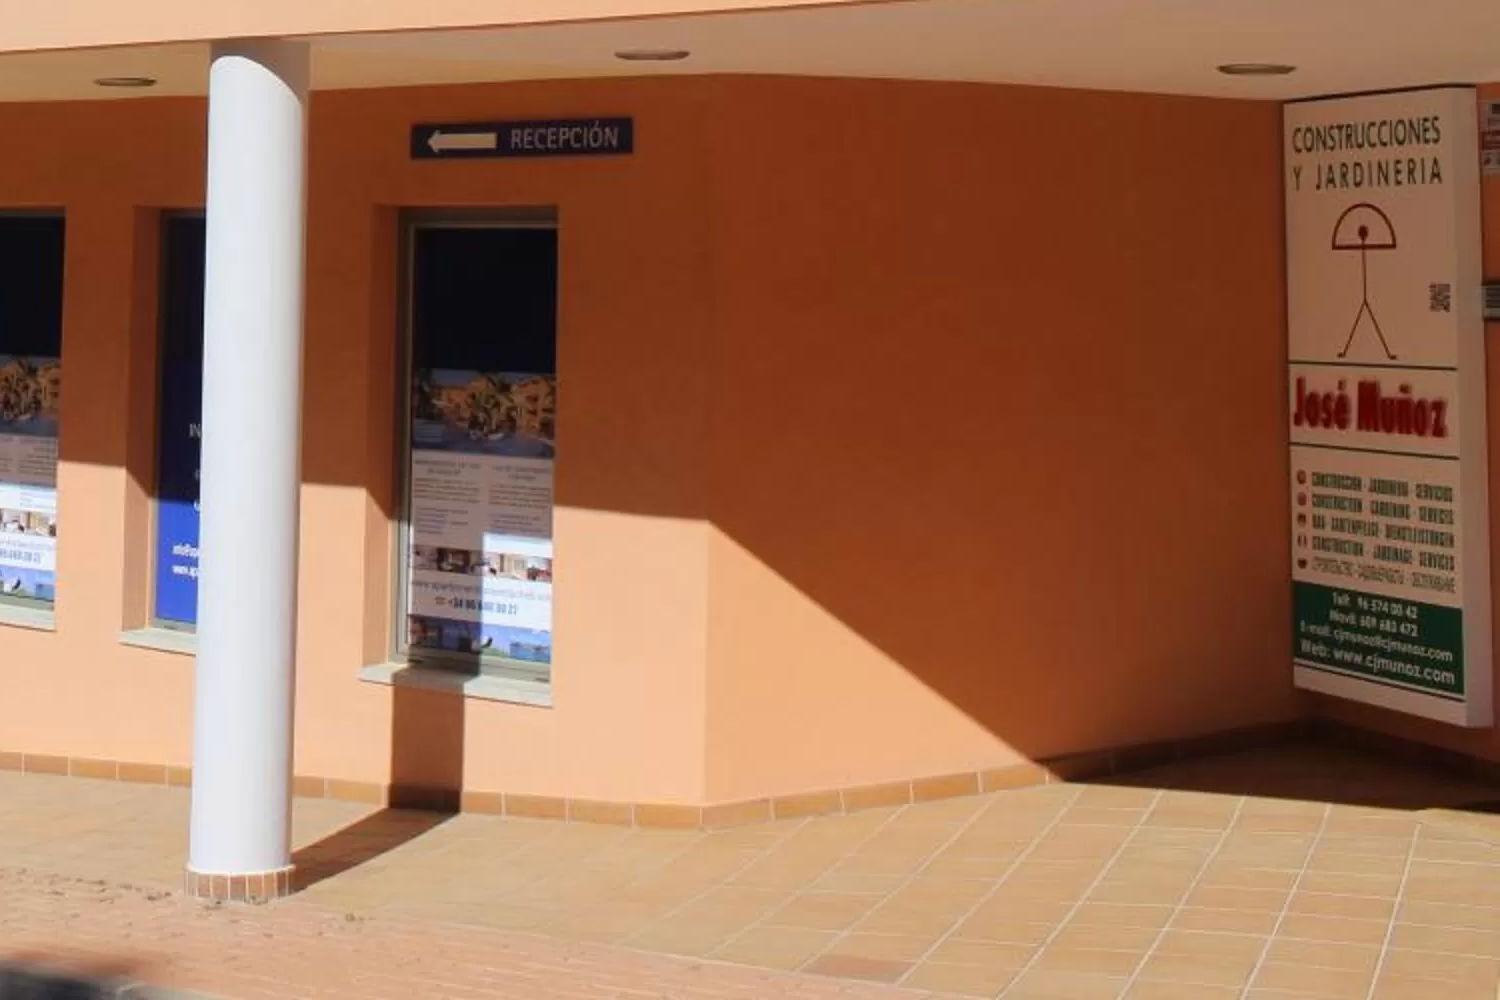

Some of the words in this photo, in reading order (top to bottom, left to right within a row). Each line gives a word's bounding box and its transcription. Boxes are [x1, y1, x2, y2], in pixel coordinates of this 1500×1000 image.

[511, 120, 618, 149] RECEPCIÓN
[1292, 116, 1441, 154] CONSTRUCCIONES
[1292, 165, 1302, 192] Y
[1315, 156, 1443, 191] JARDINERIA
[1294, 376, 1349, 431] José
[1357, 379, 1448, 438] Muñoz
[1333, 647, 1455, 685] www.cjmunoz.com
